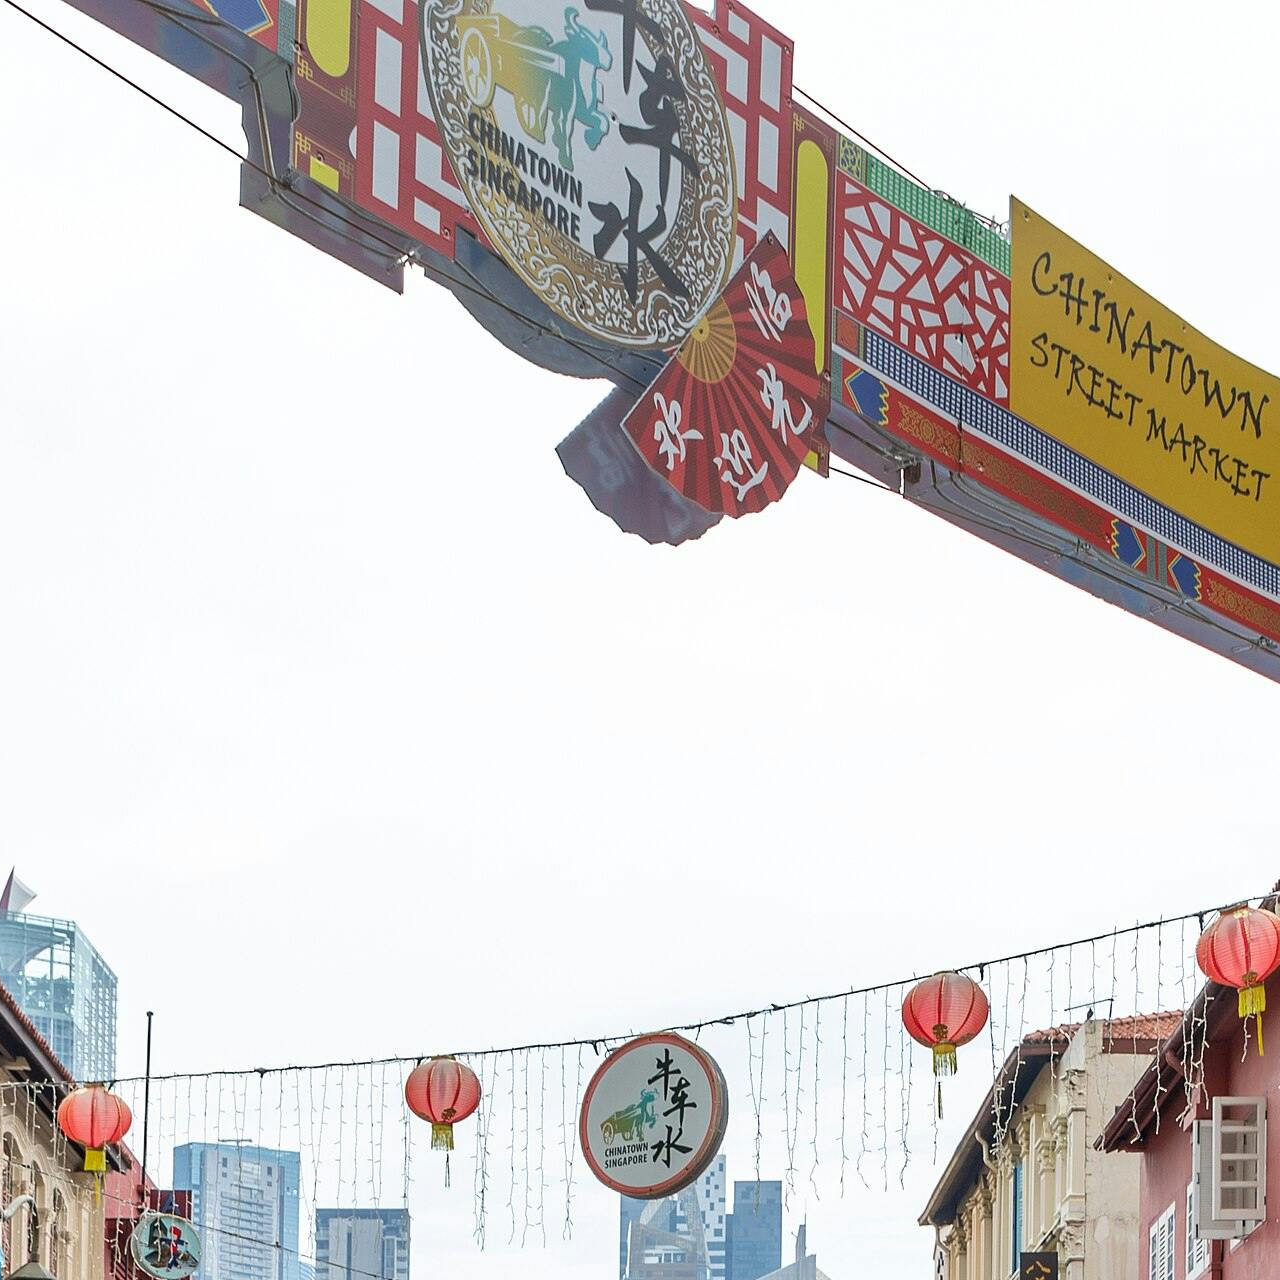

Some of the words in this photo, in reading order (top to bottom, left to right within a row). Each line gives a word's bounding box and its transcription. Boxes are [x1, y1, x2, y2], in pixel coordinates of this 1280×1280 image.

[467, 150, 581, 243] SINGAPORE
[468, 112, 583, 209] CHINATOWN
[1031, 252, 1269, 439] CHINATOWN
[1031, 333, 1143, 426] STREET
[1146, 408, 1270, 501] MARKET
[604, 1141, 649, 1158] CHINATOWN
[647, 1048, 697, 1169] 牛车水
[604, 1153, 648, 1169] SINGAPORE
